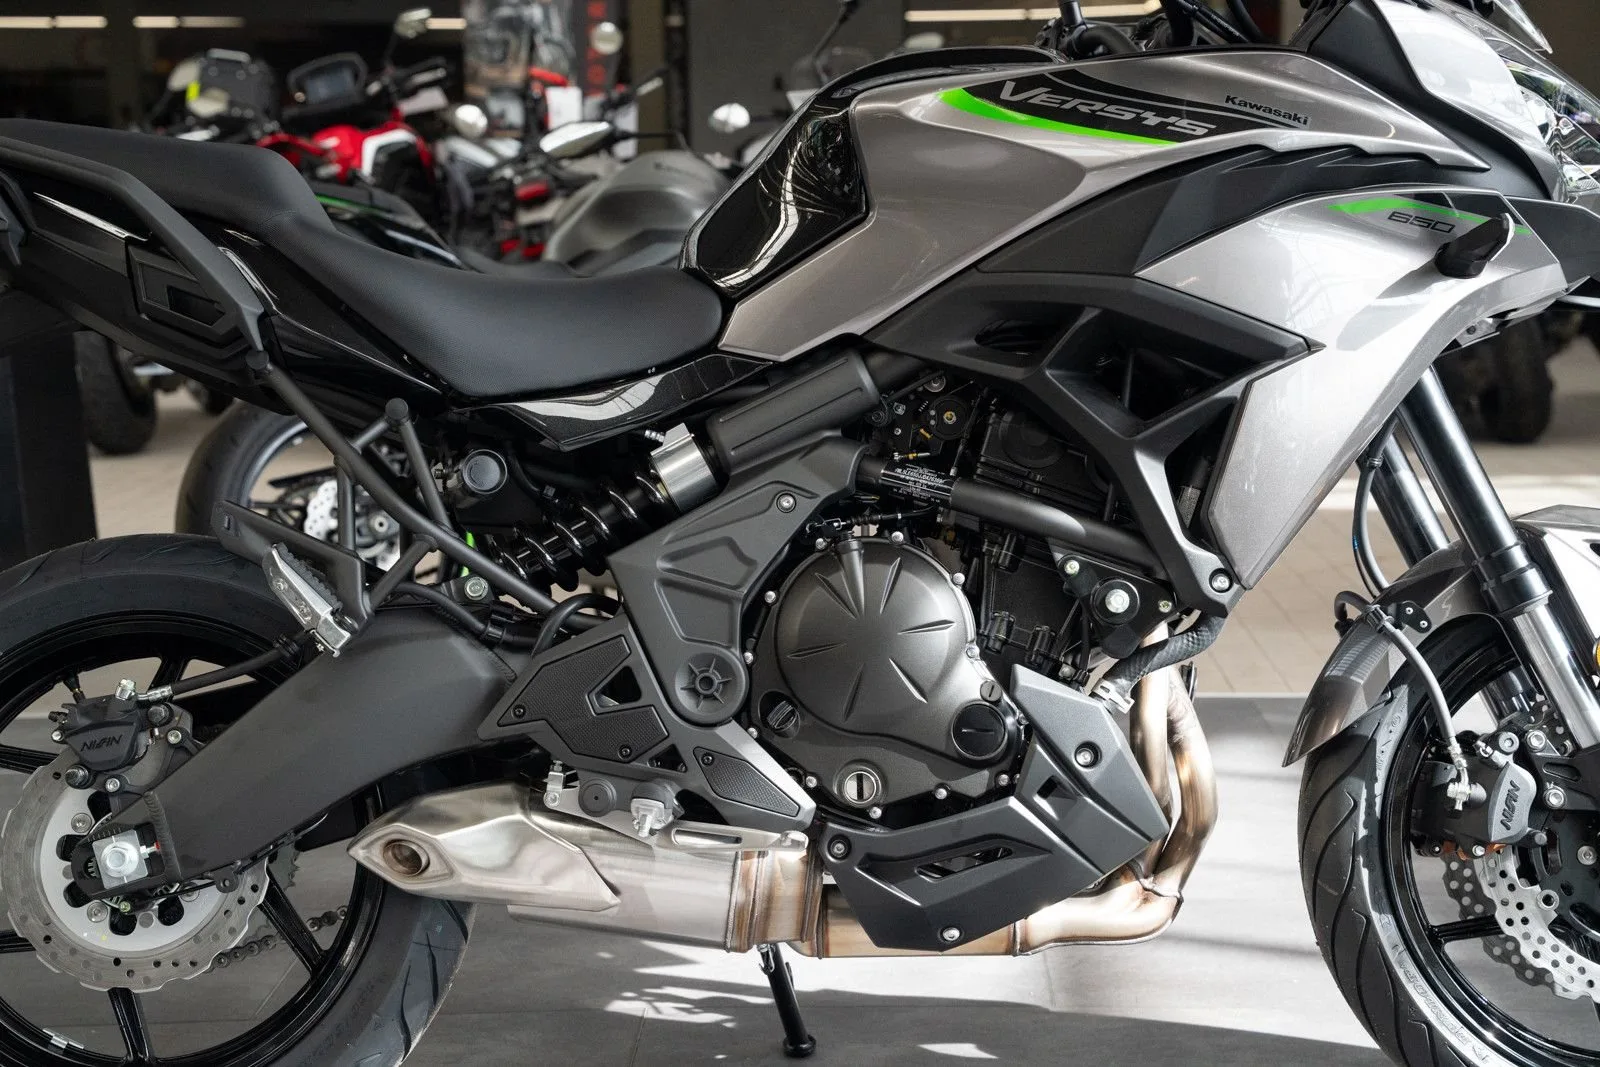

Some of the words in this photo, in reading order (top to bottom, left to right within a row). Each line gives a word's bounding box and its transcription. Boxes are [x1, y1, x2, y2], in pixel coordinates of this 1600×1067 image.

[999, 80, 1216, 136] VERSYS
[1224, 94, 1309, 126] Kawasaki
[1387, 211, 1456, 233] 650
